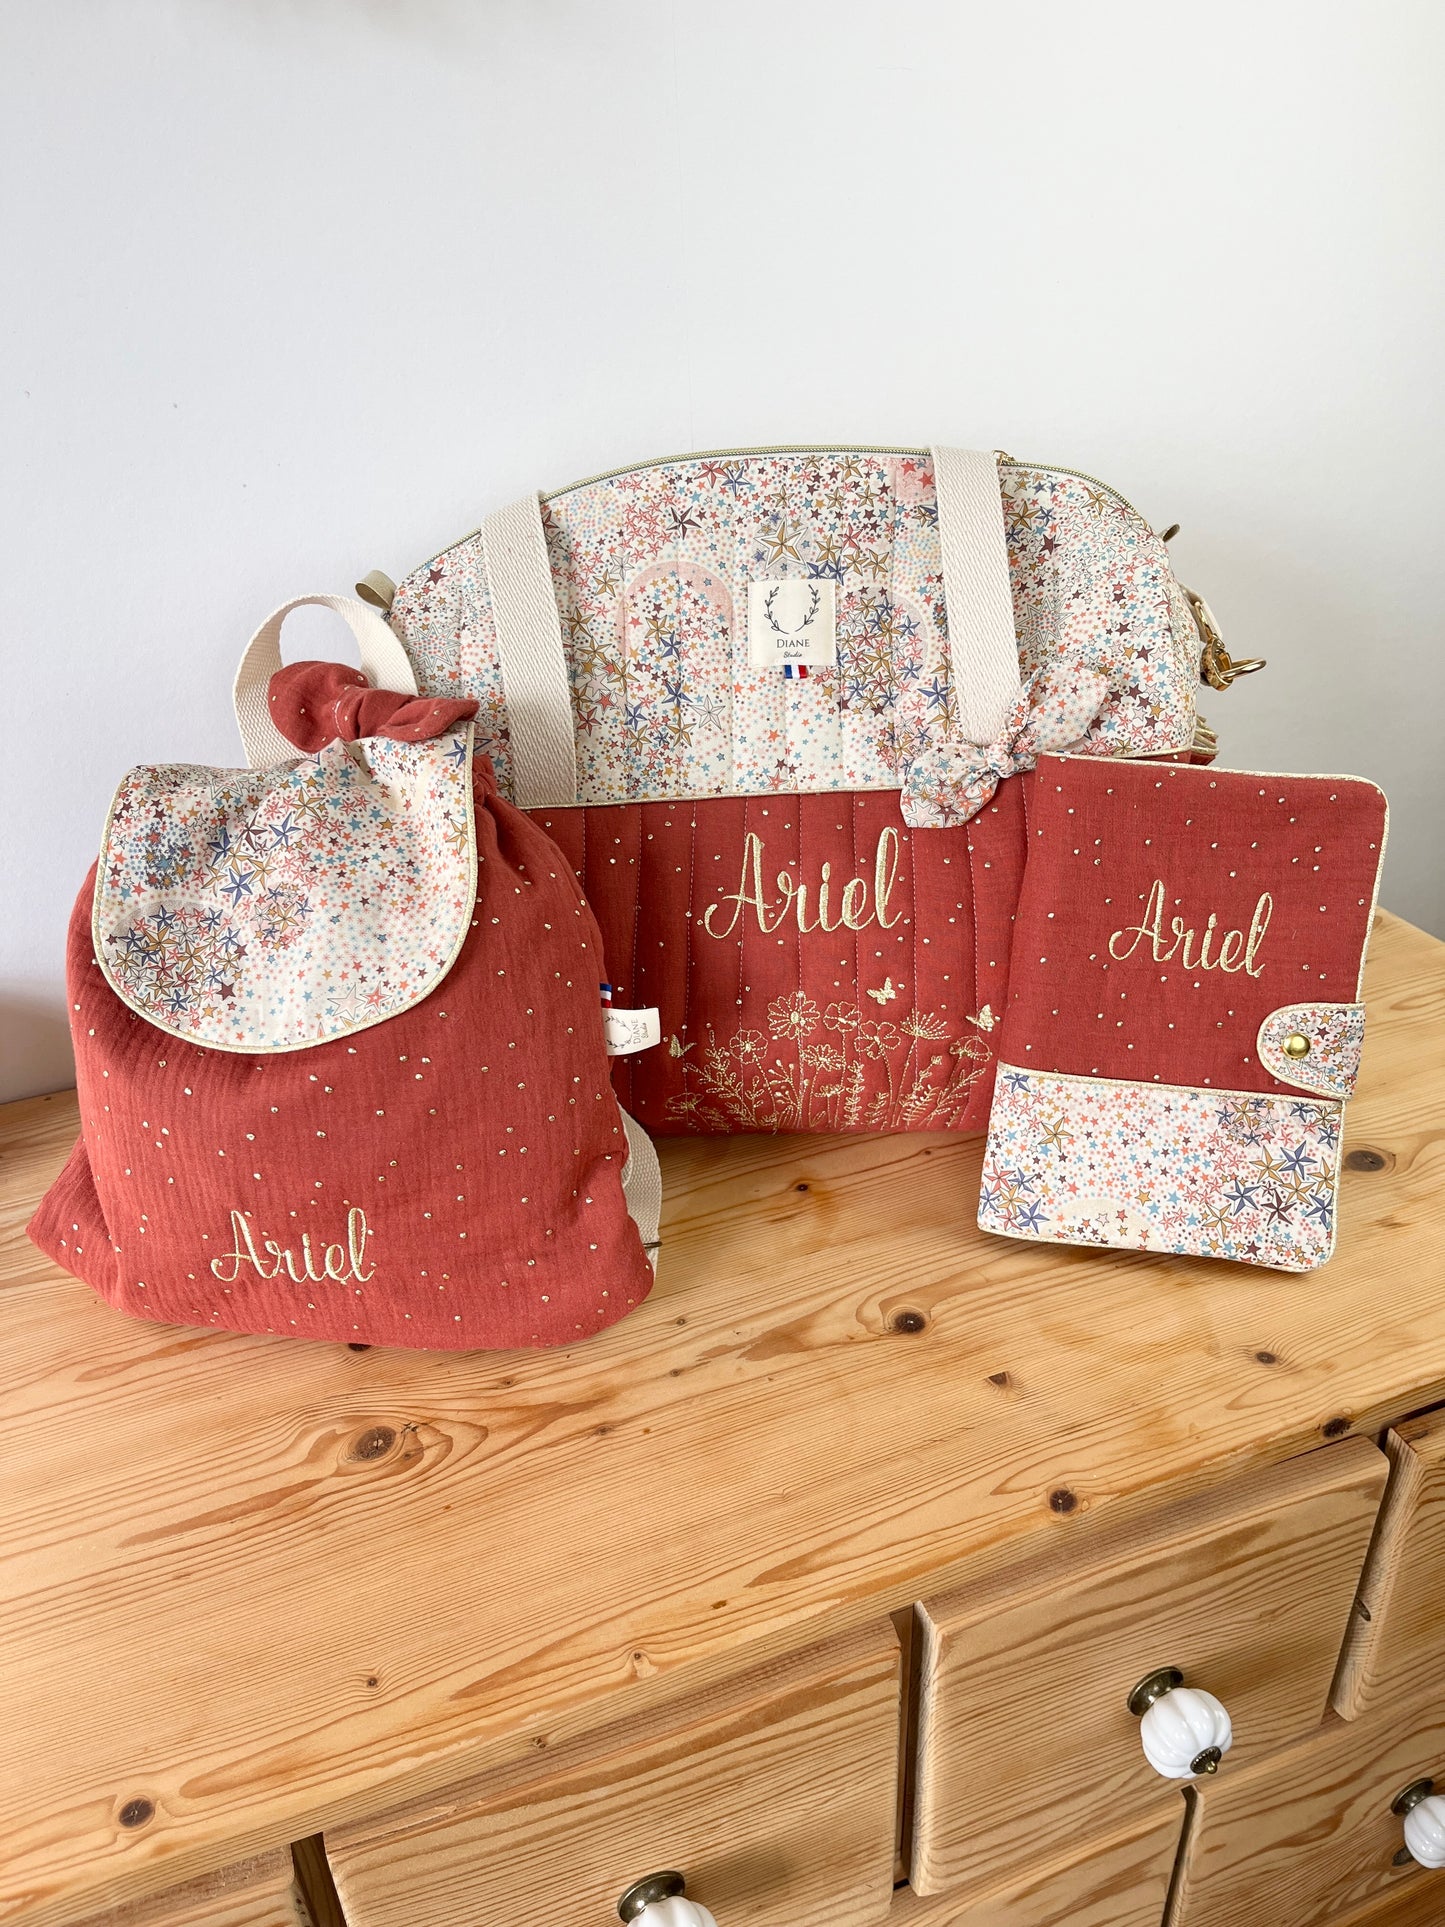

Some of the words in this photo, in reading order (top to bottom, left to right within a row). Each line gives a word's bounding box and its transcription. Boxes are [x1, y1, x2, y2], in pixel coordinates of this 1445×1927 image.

[776, 638, 810, 649] DIANE
[704, 826, 902, 939] Ariel
[1108, 879, 1273, 975] Ariel
[631, 1018, 641, 1044] DIANE
[210, 1207, 375, 1283] Ariel
